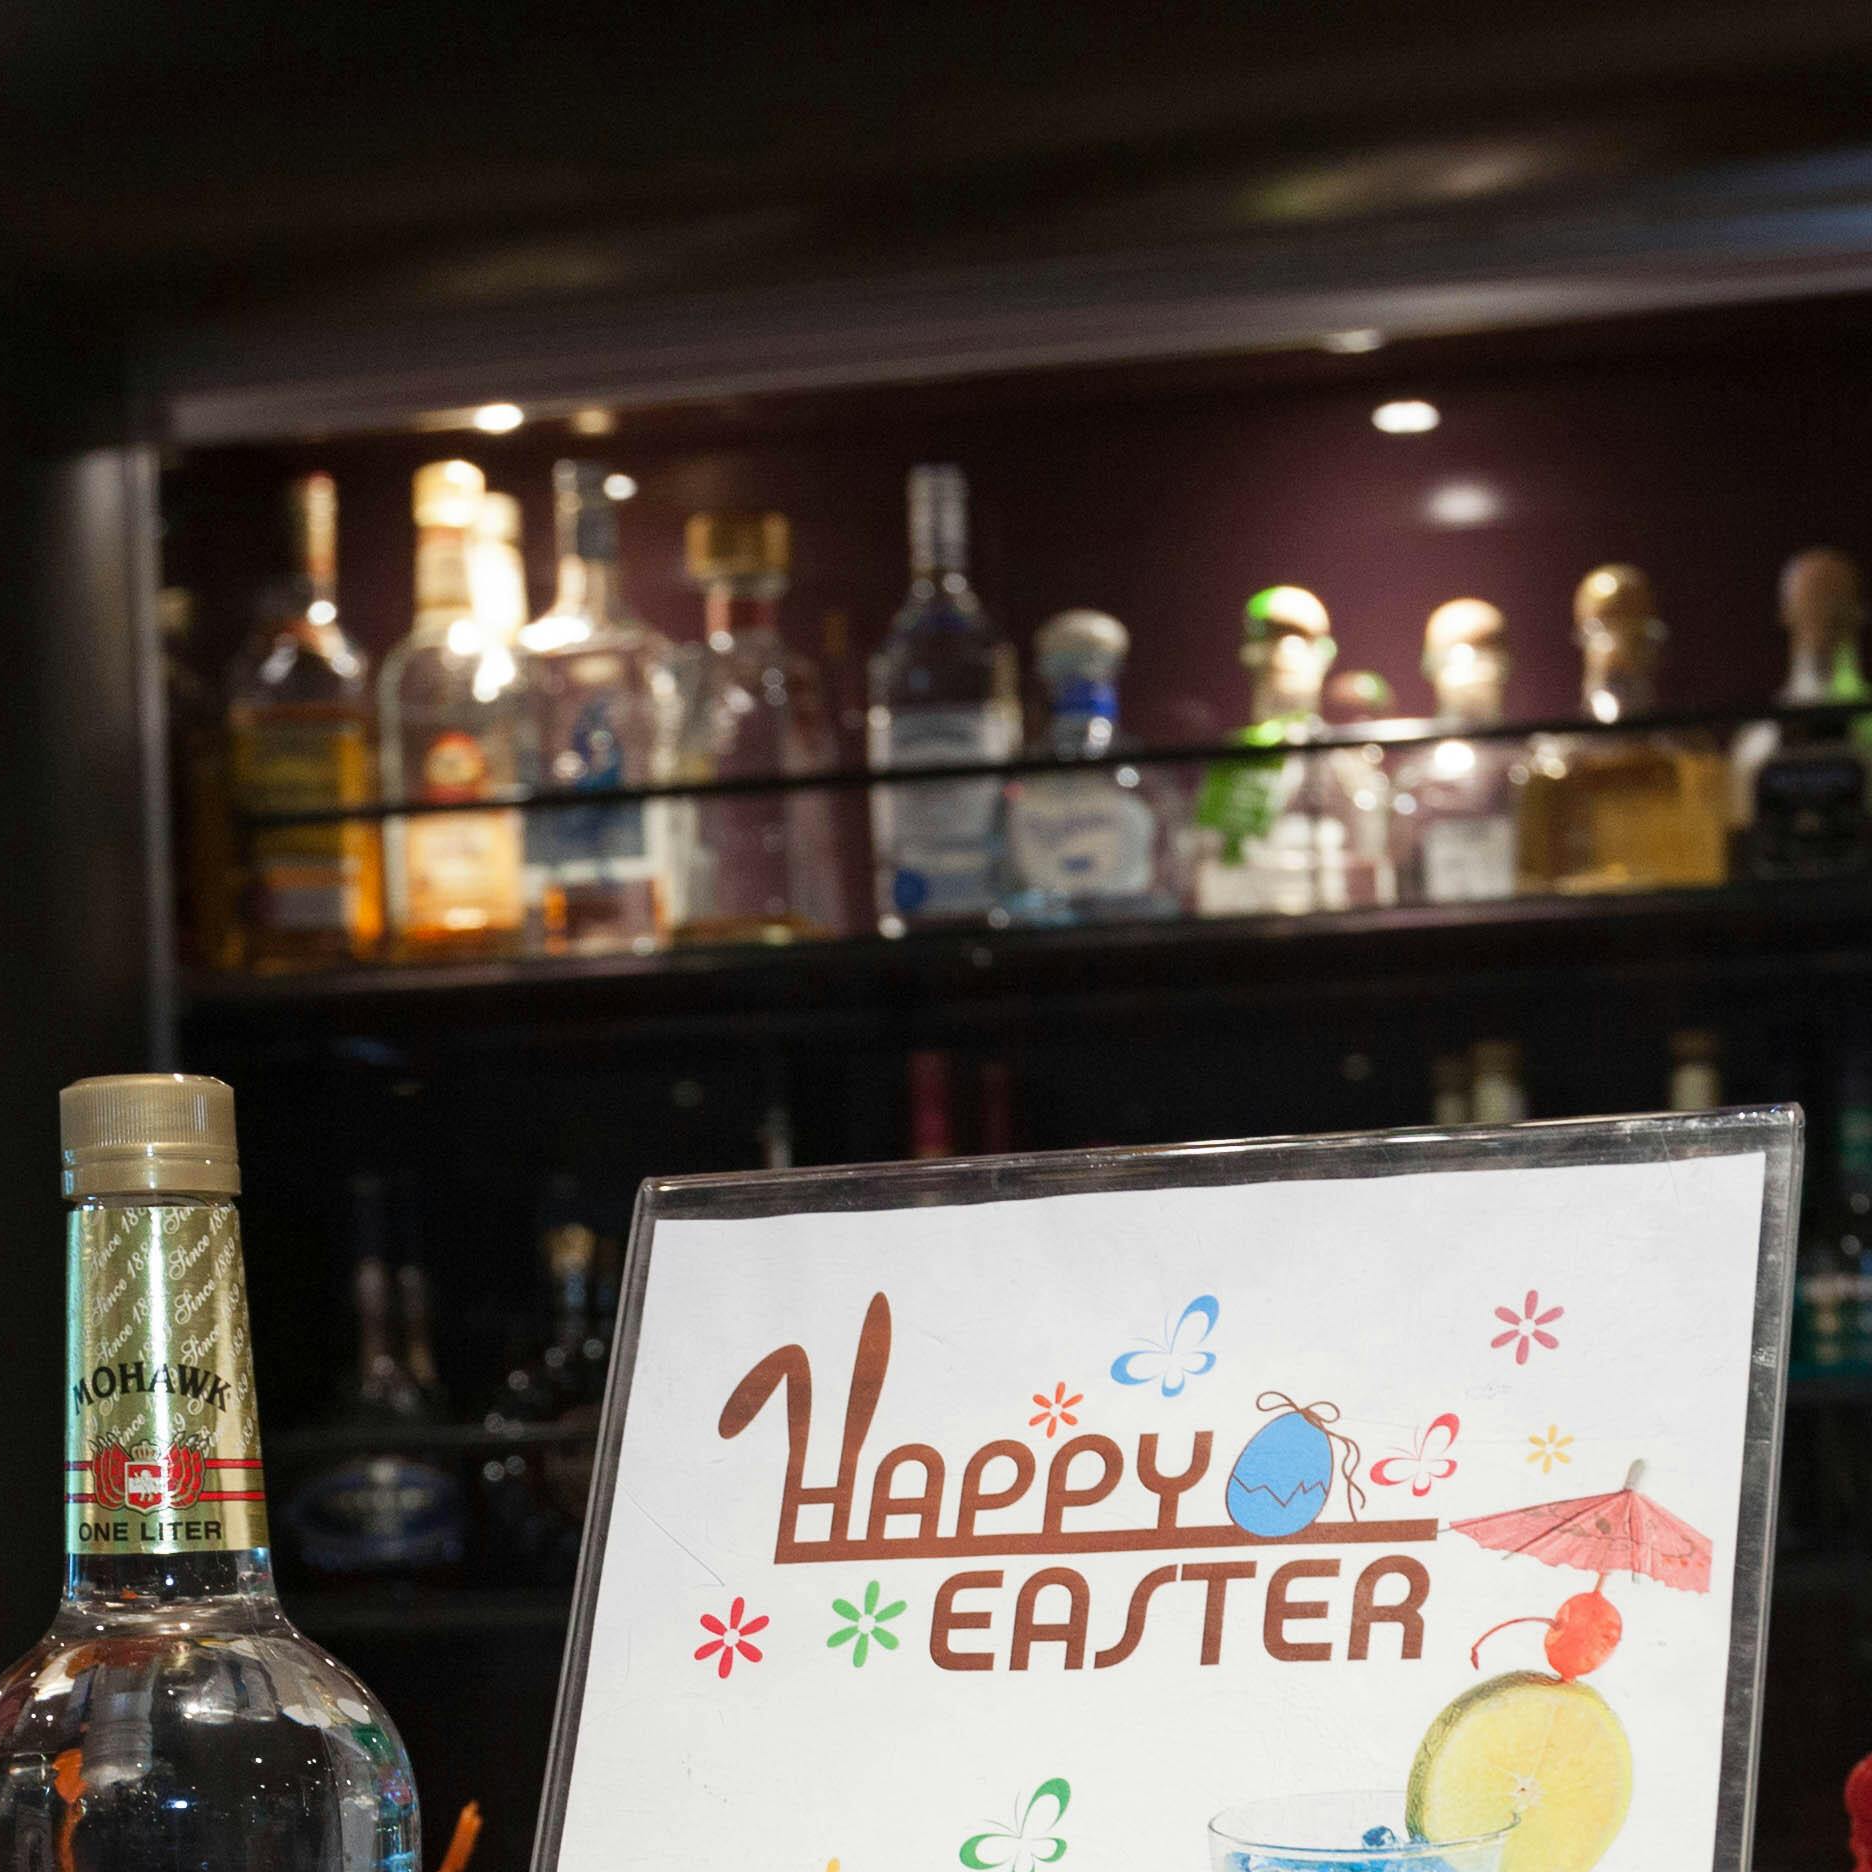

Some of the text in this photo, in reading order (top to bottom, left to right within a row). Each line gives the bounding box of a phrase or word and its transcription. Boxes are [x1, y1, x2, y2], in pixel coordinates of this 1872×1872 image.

[73, 1361, 232, 1416] MOHAWK
[718, 1290, 1214, 1562] HAPPY
[79, 1520, 223, 1543] ONE LITER
[928, 1553, 1433, 1672] EASTER
